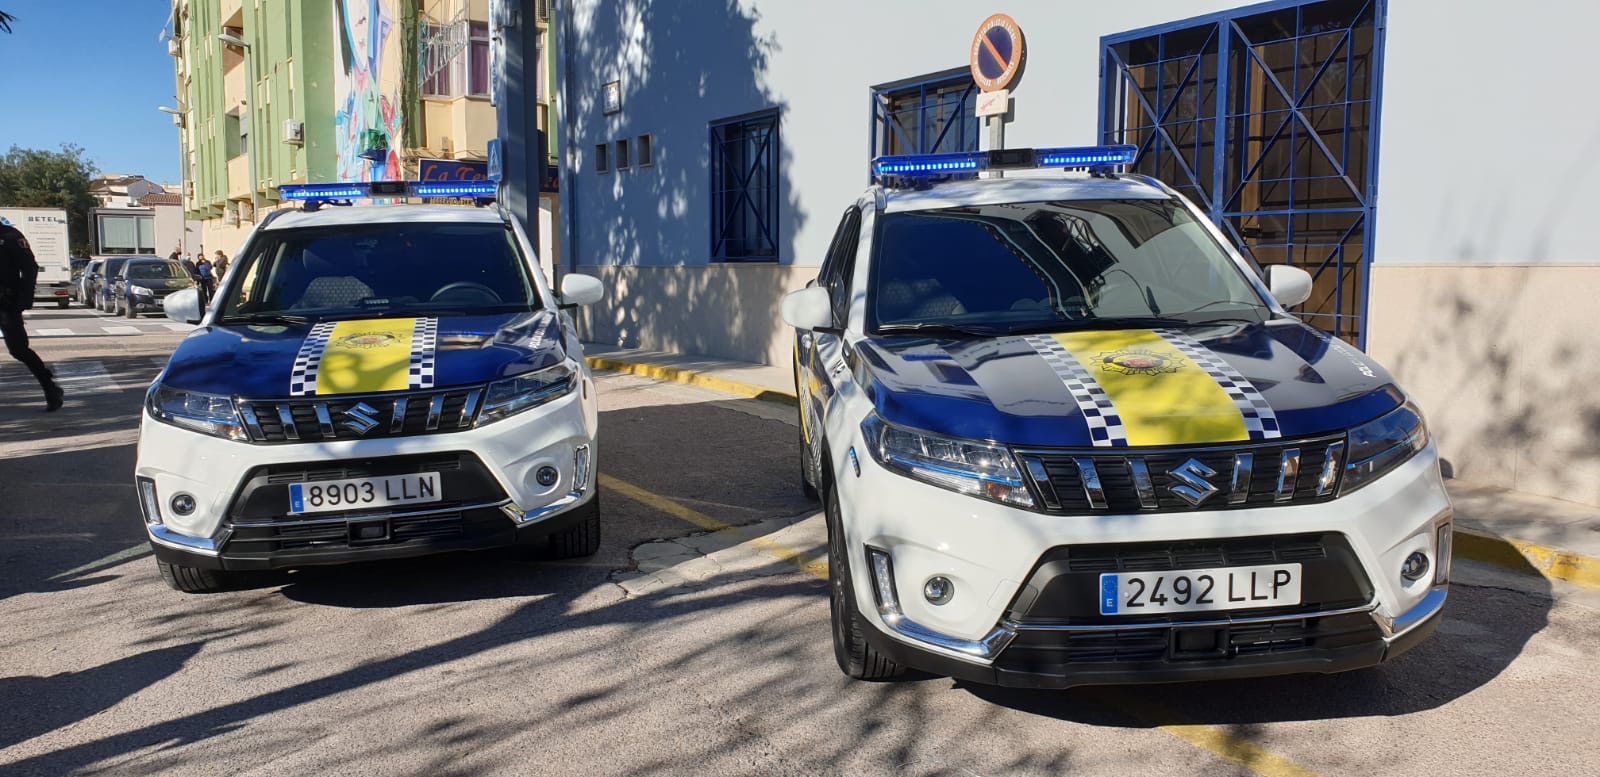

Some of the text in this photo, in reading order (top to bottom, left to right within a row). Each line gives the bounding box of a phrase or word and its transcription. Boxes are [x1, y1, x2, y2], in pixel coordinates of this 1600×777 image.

[423, 164, 448, 181] La
[309, 476, 434, 507] 8903 LLN
[1126, 569, 1291, 607] 2492 LLP
[1106, 598, 1113, 607] E
